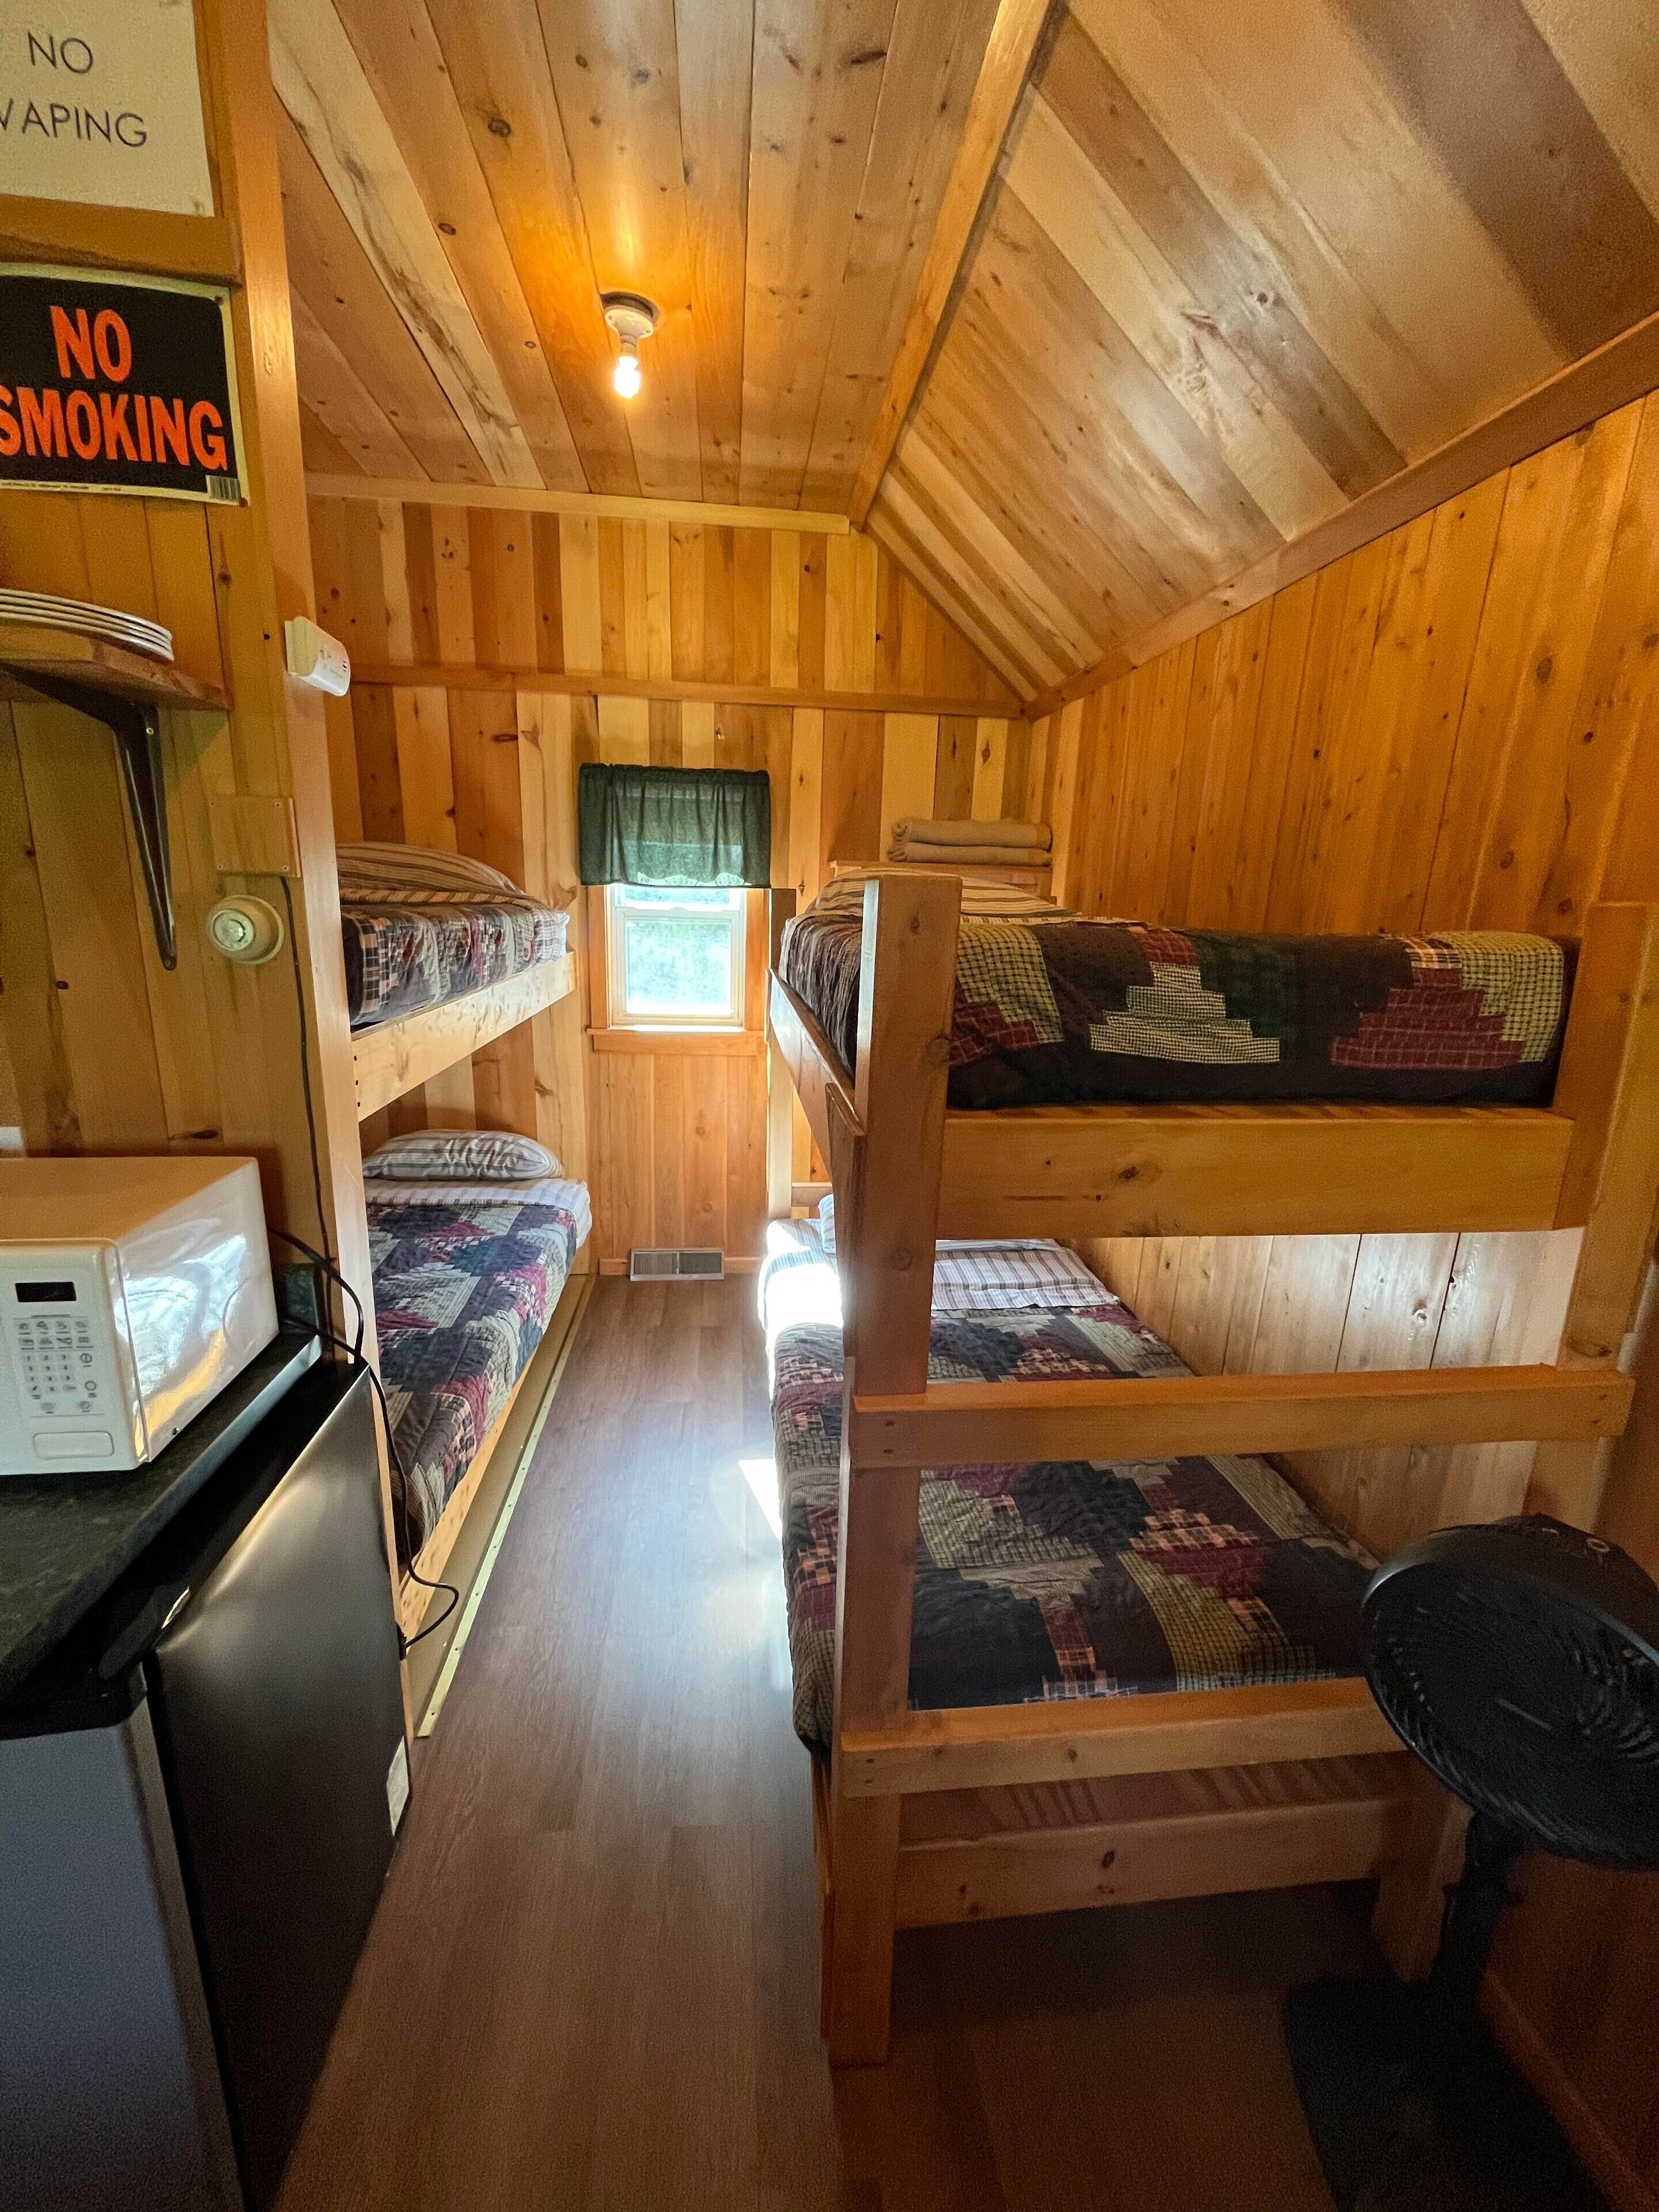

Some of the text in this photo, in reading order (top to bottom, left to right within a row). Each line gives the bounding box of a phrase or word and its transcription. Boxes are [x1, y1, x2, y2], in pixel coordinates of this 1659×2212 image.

[28, 31, 93, 74] NO
[49, 305, 132, 382] NO
[0, 385, 228, 471] SMOKING
